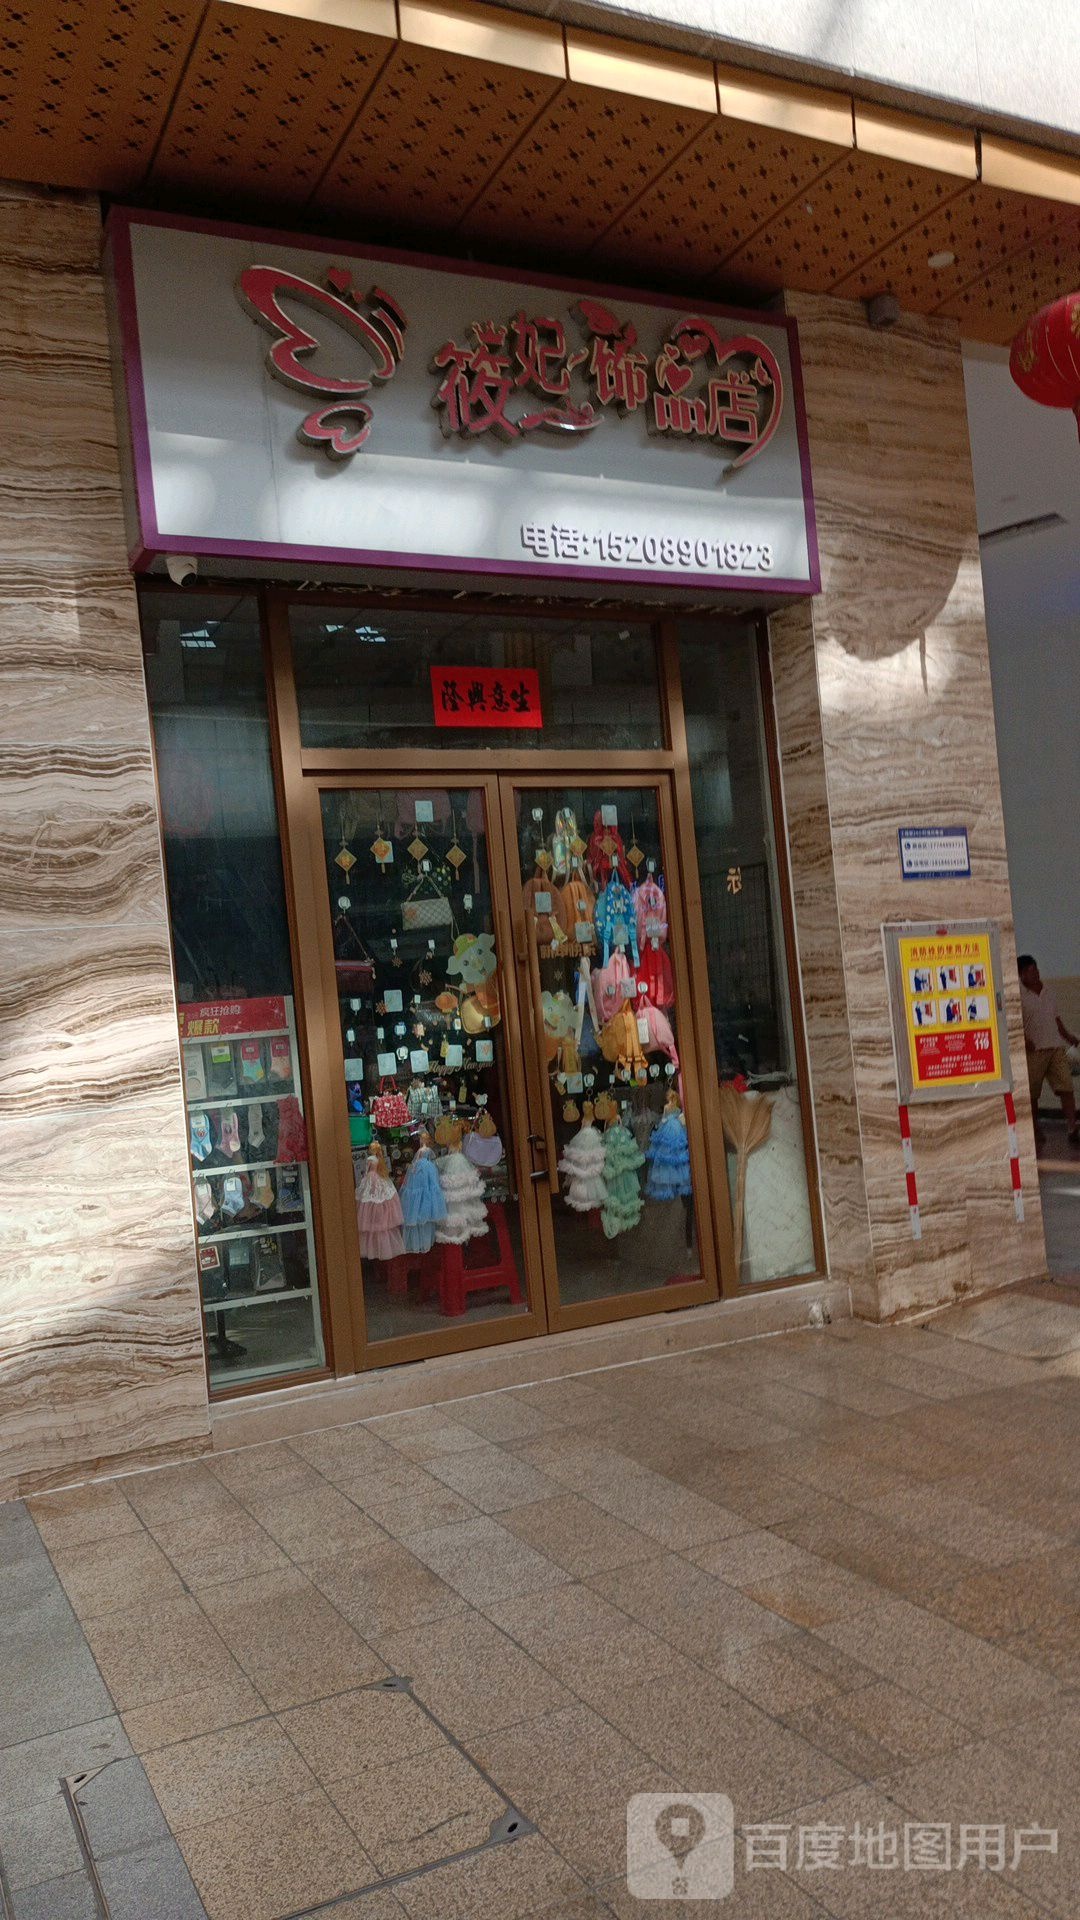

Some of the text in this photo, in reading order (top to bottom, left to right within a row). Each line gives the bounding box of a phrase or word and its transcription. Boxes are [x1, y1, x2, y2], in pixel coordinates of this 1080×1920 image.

[200, 1005, 241, 1017] 疯狂抢购
[187, 1018, 220, 1037] 爆款
